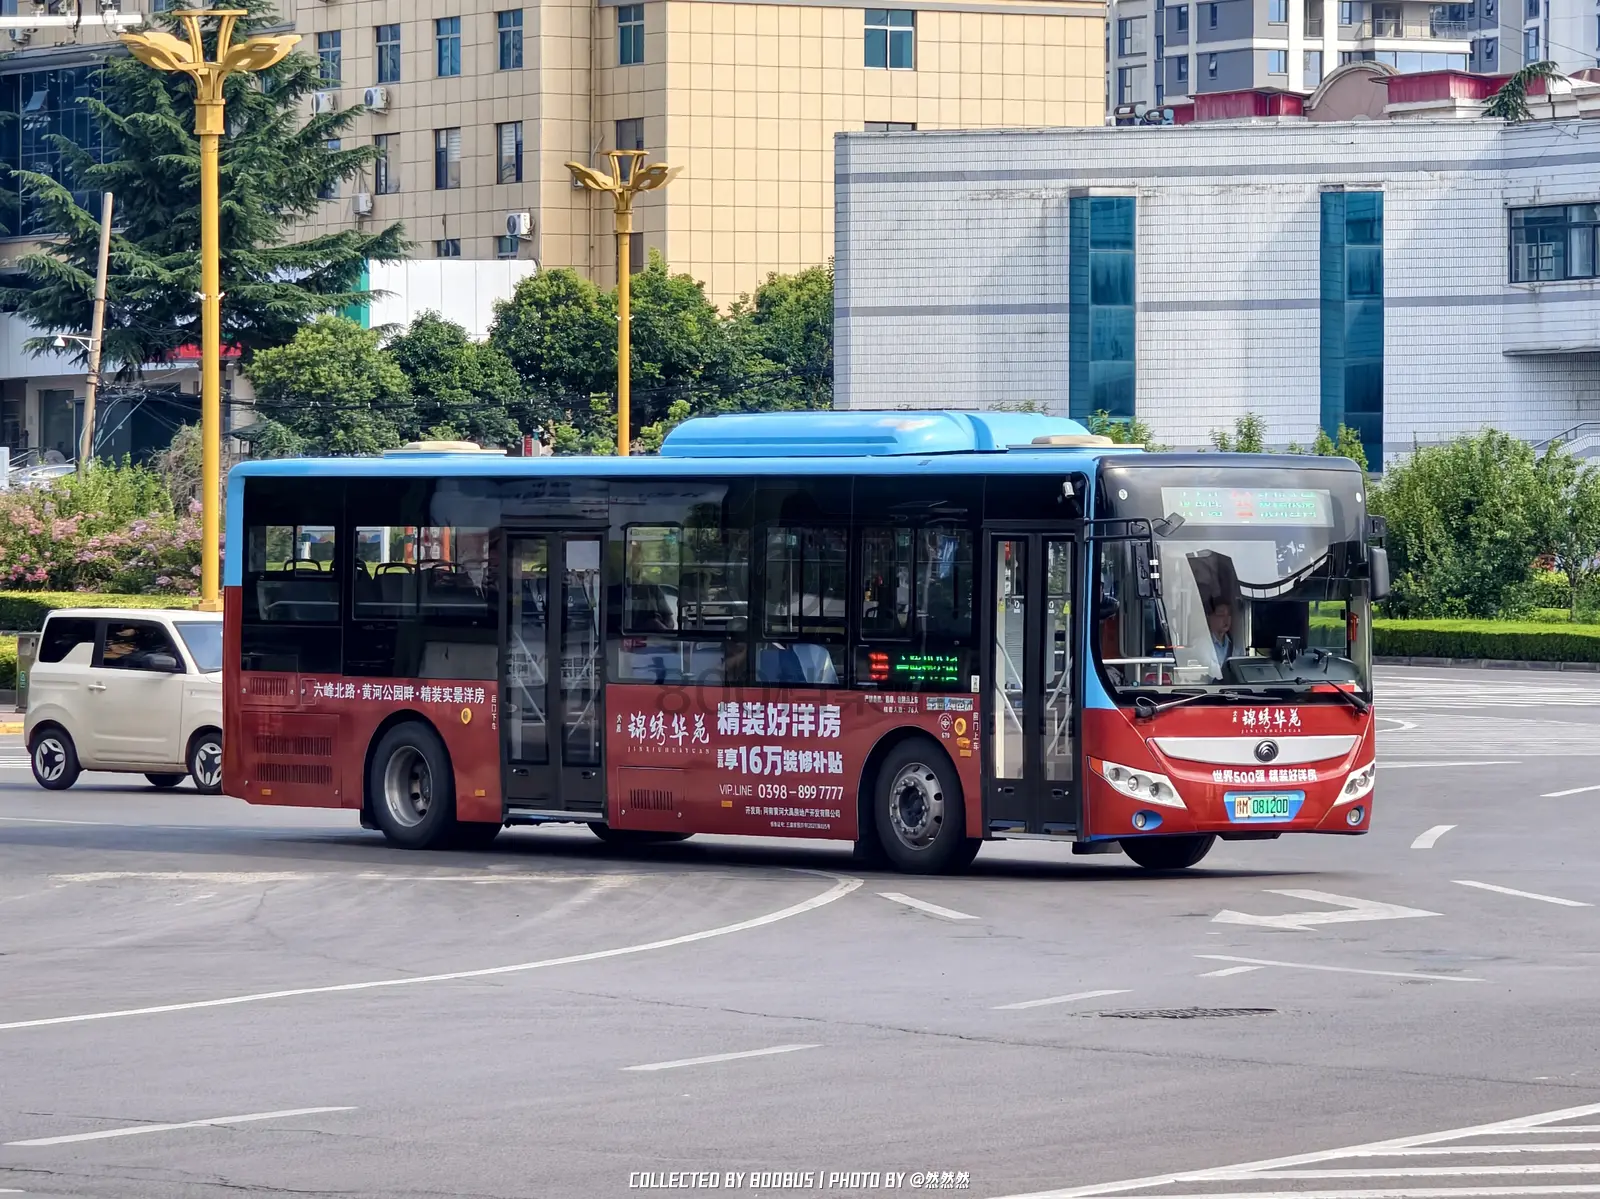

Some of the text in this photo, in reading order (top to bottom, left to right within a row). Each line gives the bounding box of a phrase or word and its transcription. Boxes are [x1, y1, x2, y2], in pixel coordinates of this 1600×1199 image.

[628, 710, 710, 746] 锦绣华苑
[717, 701, 841, 738] 精装好洋房
[1241, 707, 1301, 729] 锦绣华苑
[1212, 769, 1266, 783] 世界500强
[718, 783, 753, 796] VIP.LINE
